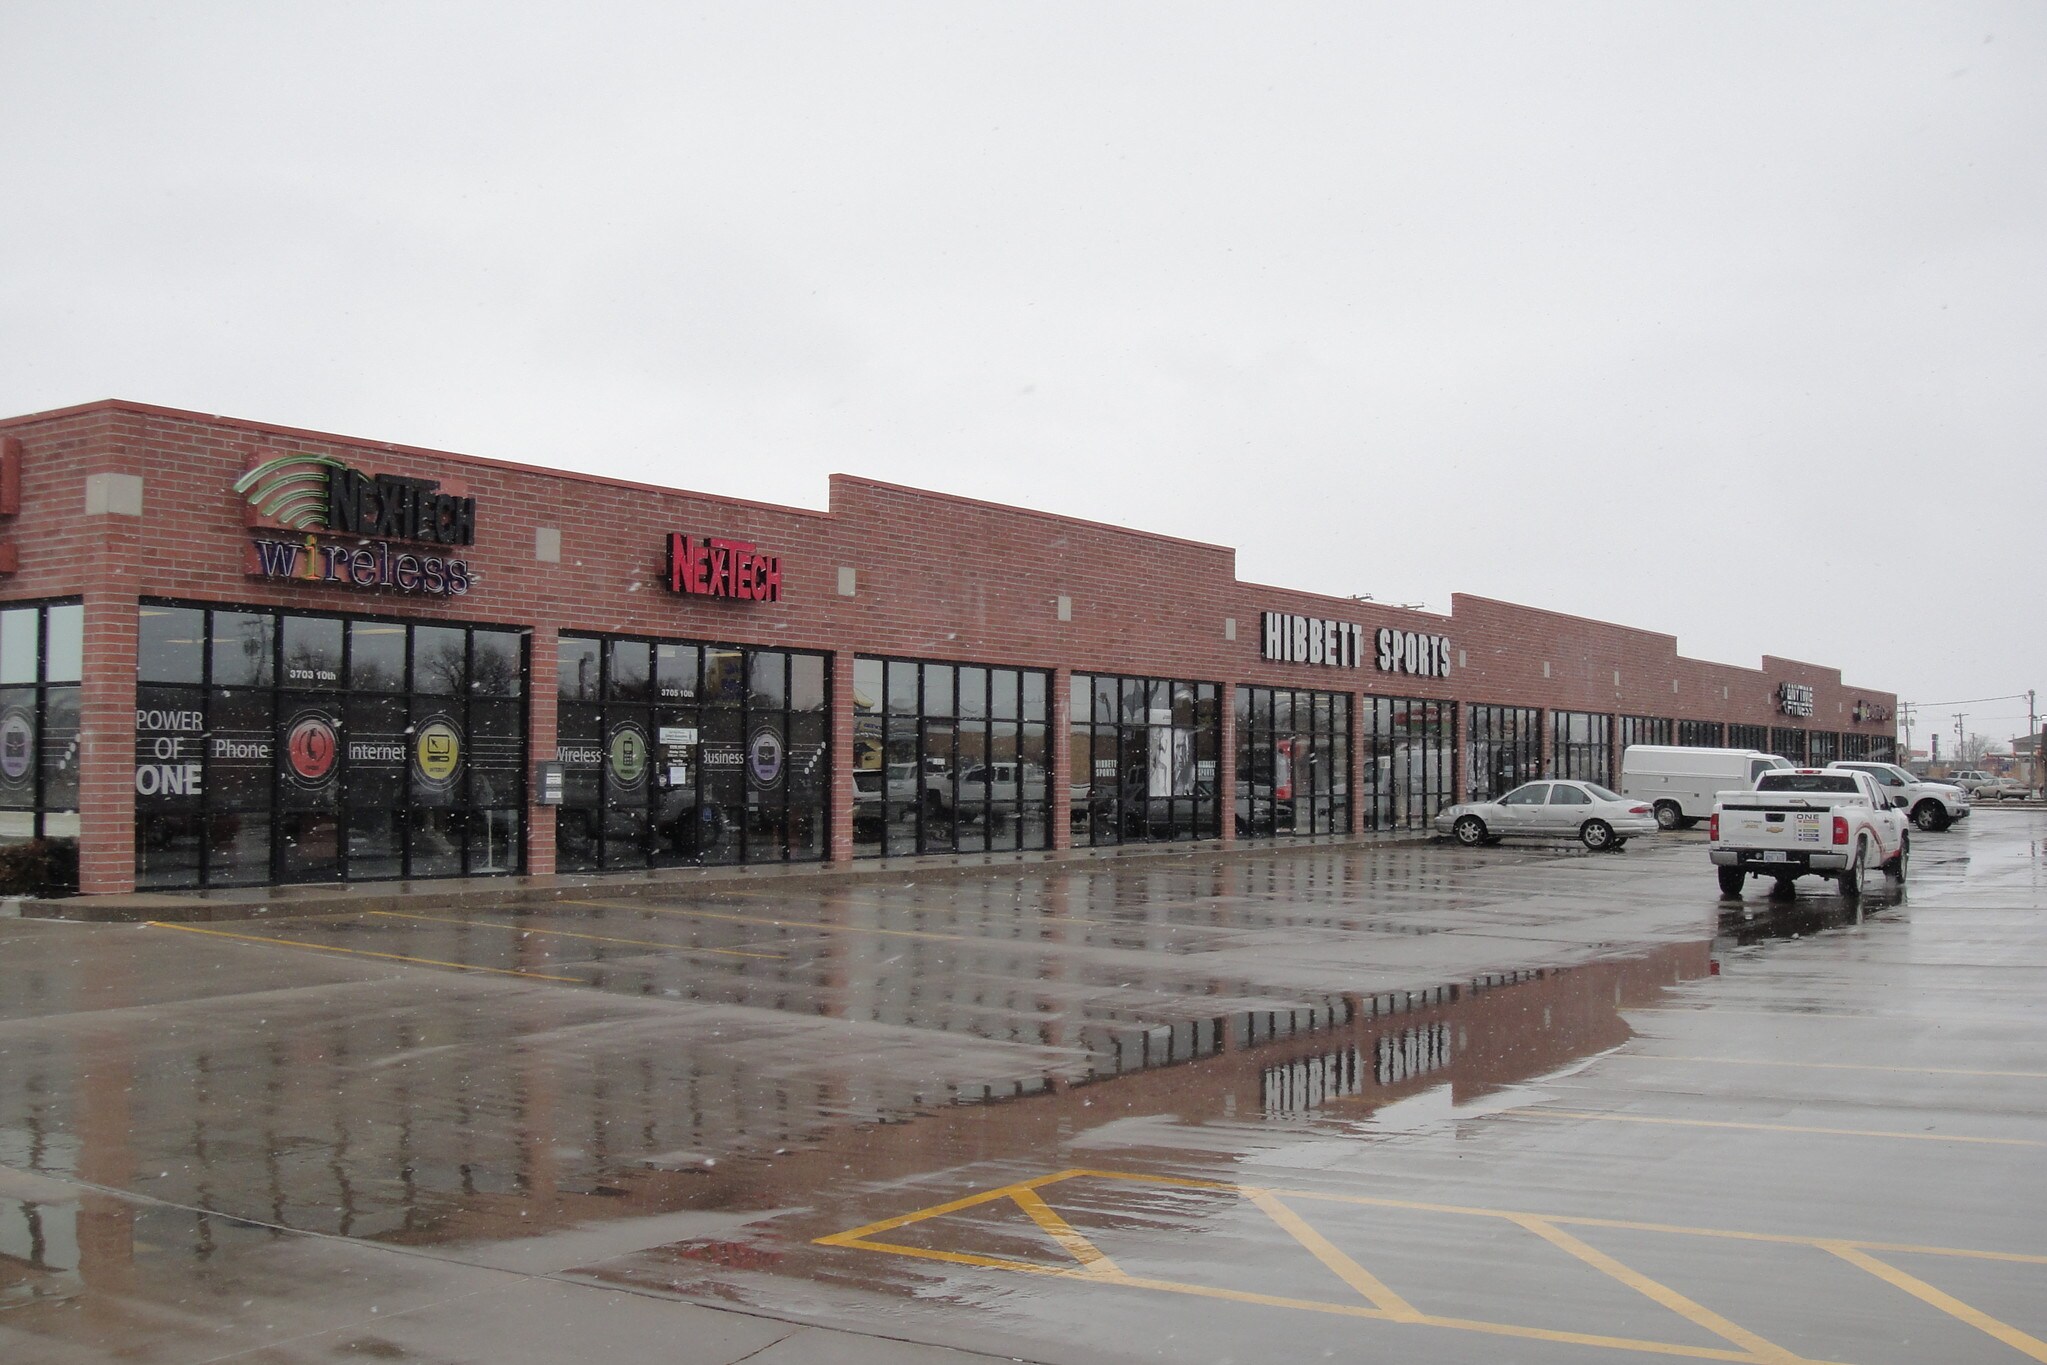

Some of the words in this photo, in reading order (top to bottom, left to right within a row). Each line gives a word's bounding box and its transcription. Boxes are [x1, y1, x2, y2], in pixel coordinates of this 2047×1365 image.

[255, 534, 470, 595] wireless
[1262, 612, 1363, 668] HIBBETT
[1375, 627, 1451, 677] SPORTS
[289, 669, 314, 679] 3703
[316, 670, 336, 680] 10th
[661, 688, 679, 697] 3705
[136, 710, 203, 731] POWER
[155, 737, 184, 760] OF
[216, 739, 269, 758] Phone
[136, 765, 203, 795] ONE
[1095, 768, 1116, 777] SPORTS
